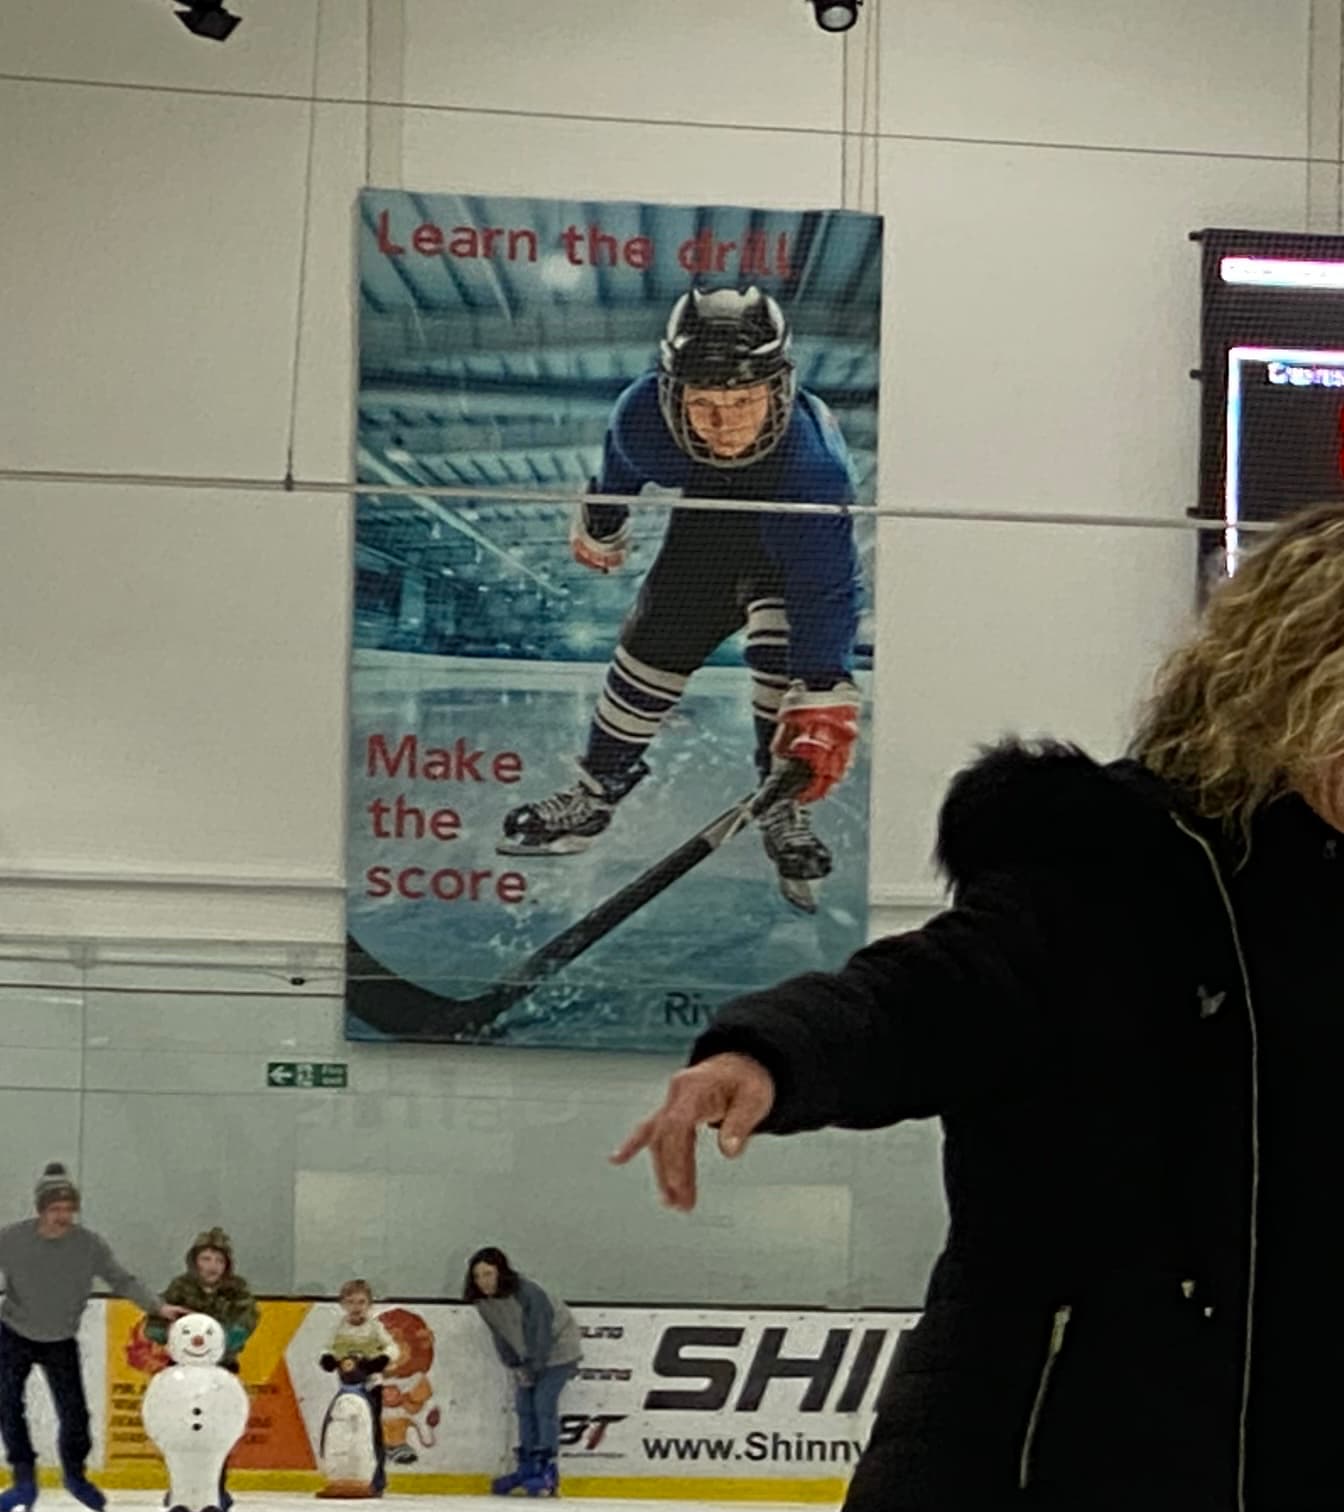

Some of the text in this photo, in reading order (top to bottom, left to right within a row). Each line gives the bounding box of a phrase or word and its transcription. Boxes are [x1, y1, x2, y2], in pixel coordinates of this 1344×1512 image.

[375, 208, 539, 263] Learn
[560, 223, 656, 270] the
[366, 733, 523, 784] Make
[367, 793, 461, 841] the
[643, 1325, 889, 1412] SHI
